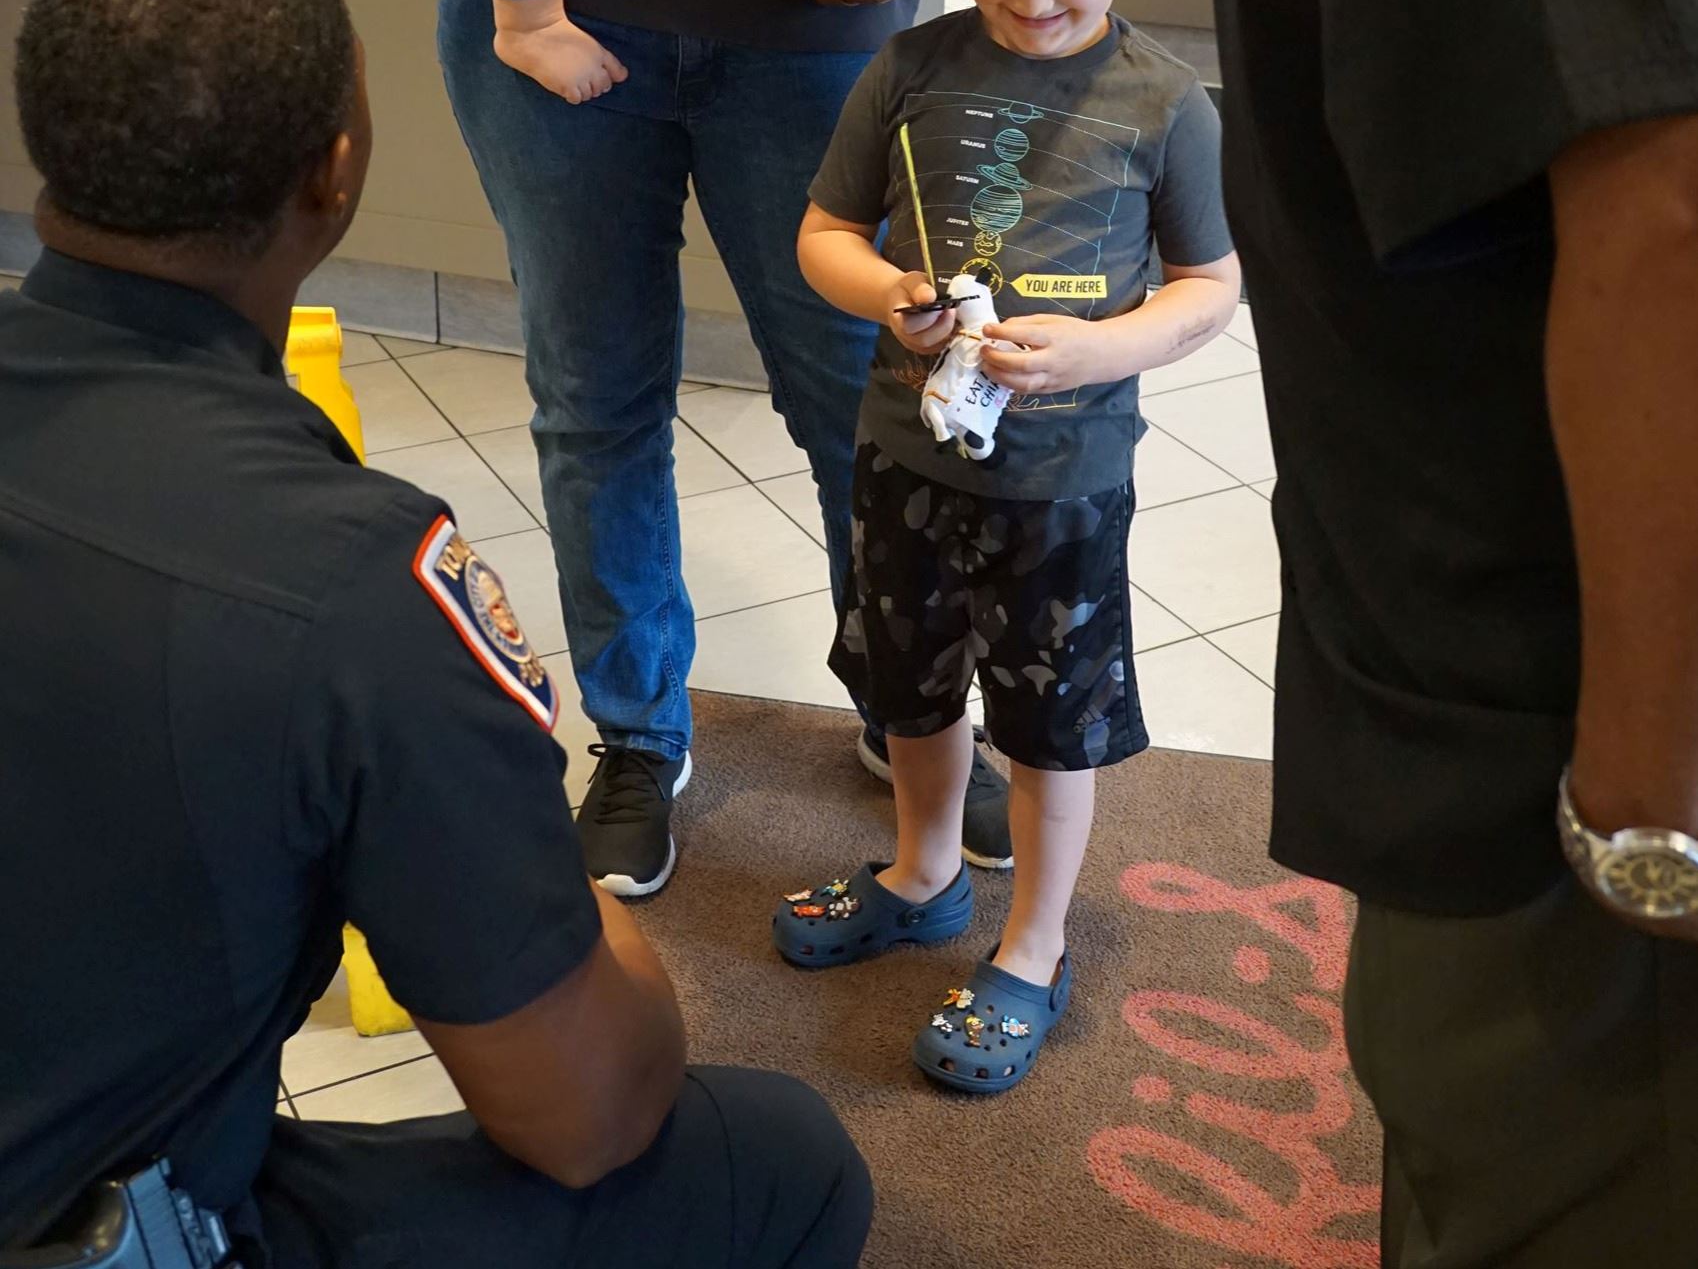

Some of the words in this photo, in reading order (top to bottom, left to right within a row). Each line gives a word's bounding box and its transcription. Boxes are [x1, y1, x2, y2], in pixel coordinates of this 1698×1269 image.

[965, 108, 994, 119] NEPTUNE
[960, 139, 986, 150] URANUS
[955, 174, 980, 185] SATURN
[946, 217, 970, 227] JUPITER
[946, 239, 964, 248] MARS
[1026, 279, 1049, 292] YOU
[1052, 280, 1073, 293] ARE
[1075, 280, 1102, 293] HERE
[965, 378, 984, 405] EAT
